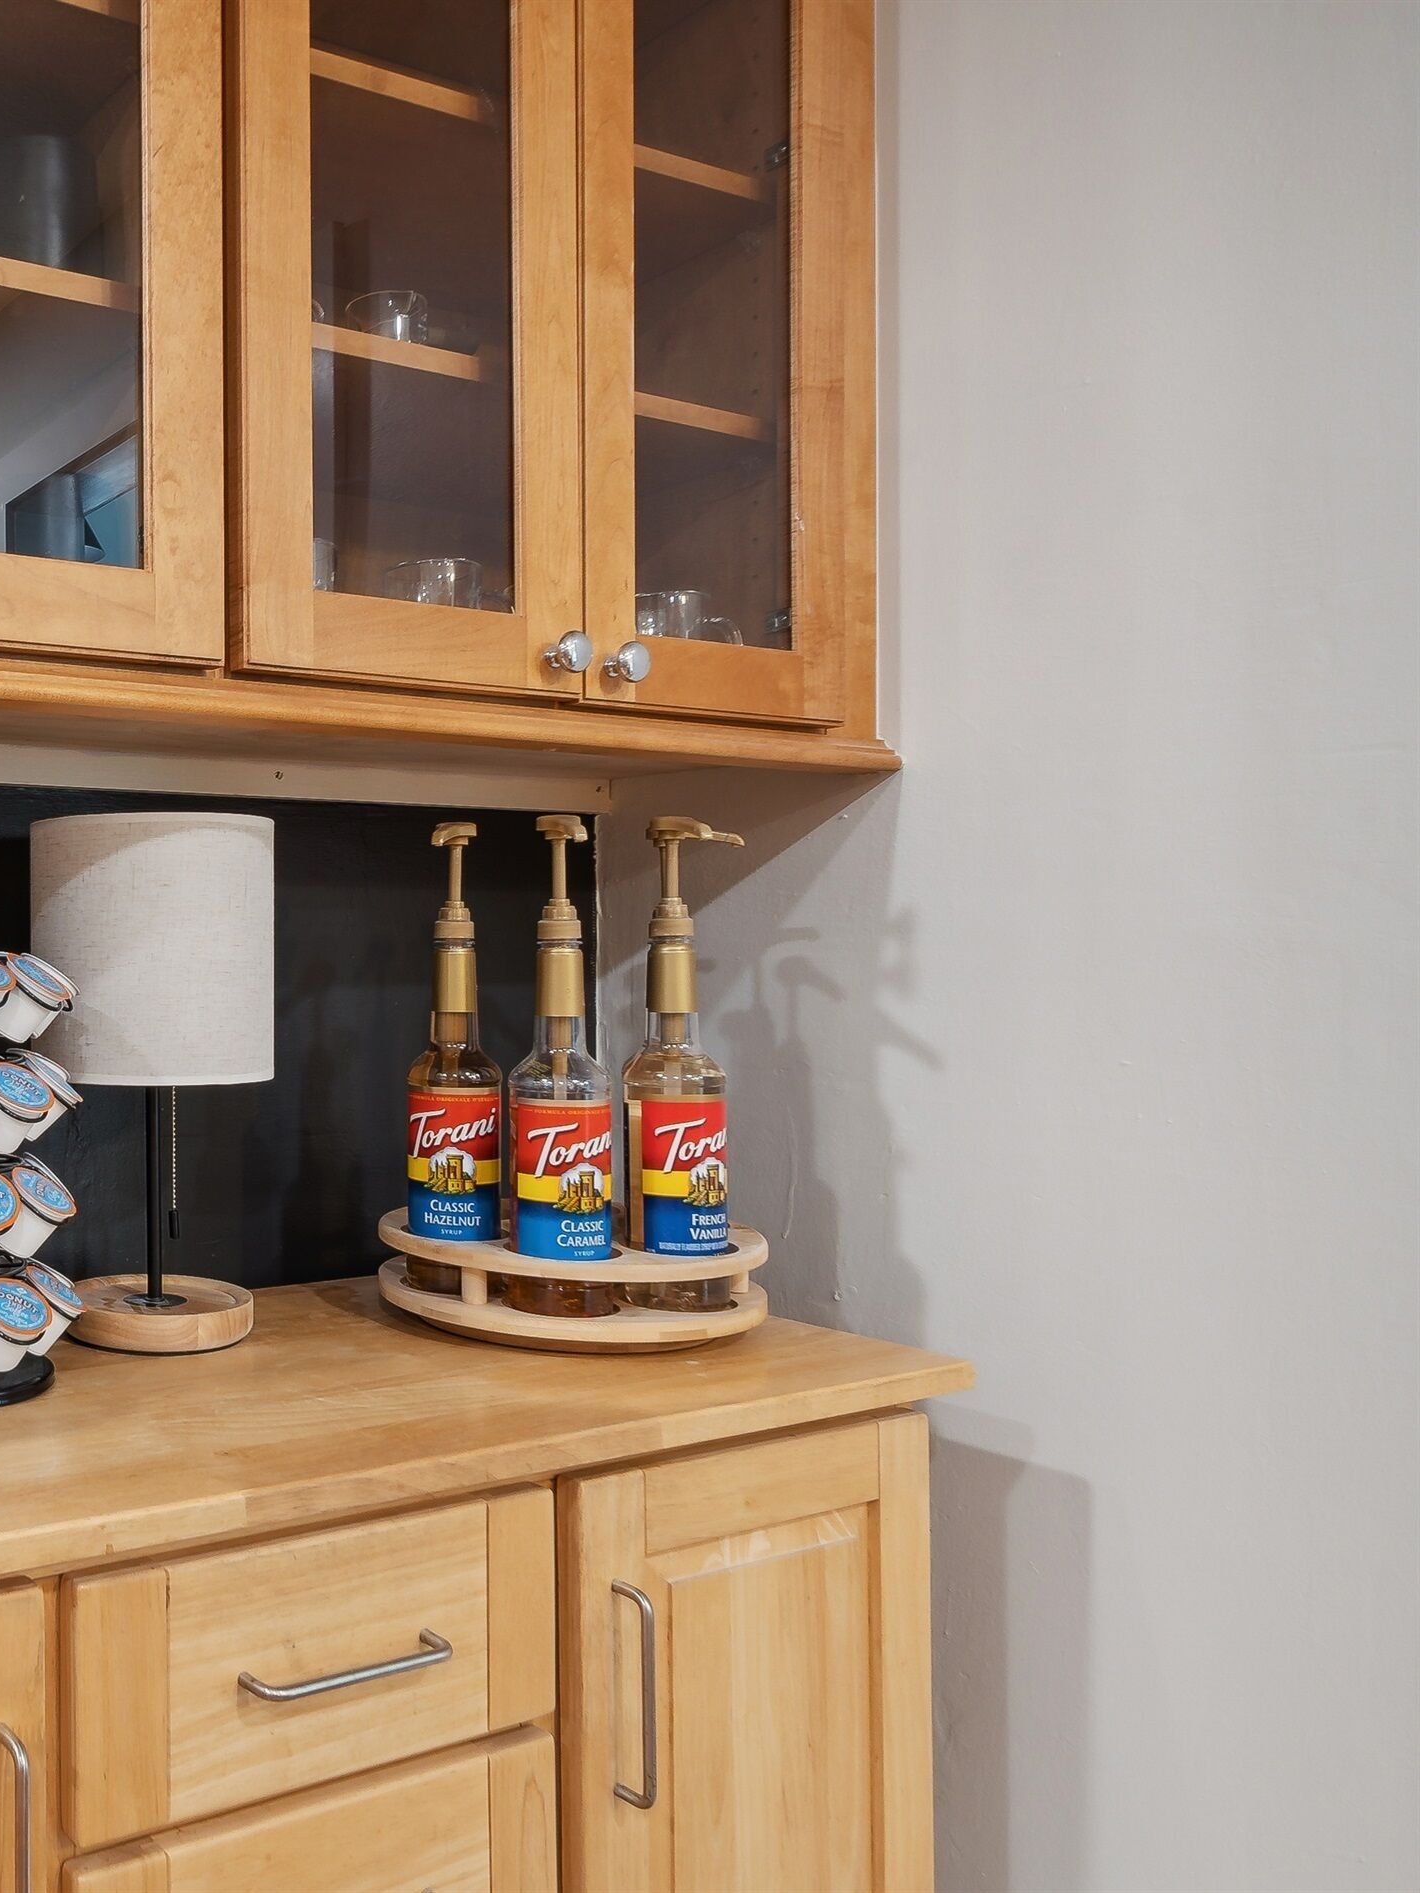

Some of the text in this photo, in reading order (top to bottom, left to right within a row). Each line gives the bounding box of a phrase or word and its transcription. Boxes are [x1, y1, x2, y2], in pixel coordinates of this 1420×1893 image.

[410, 1107, 496, 1158] Torani
[527, 1122, 611, 1178] Toran
[430, 1199, 475, 1213] CLASSIC
[424, 1212, 481, 1226] HAZELNUT
[691, 1213, 726, 1226] FRENCH
[561, 1220, 604, 1233] CLASSIC
[557, 1234, 606, 1247] CARAMEL
